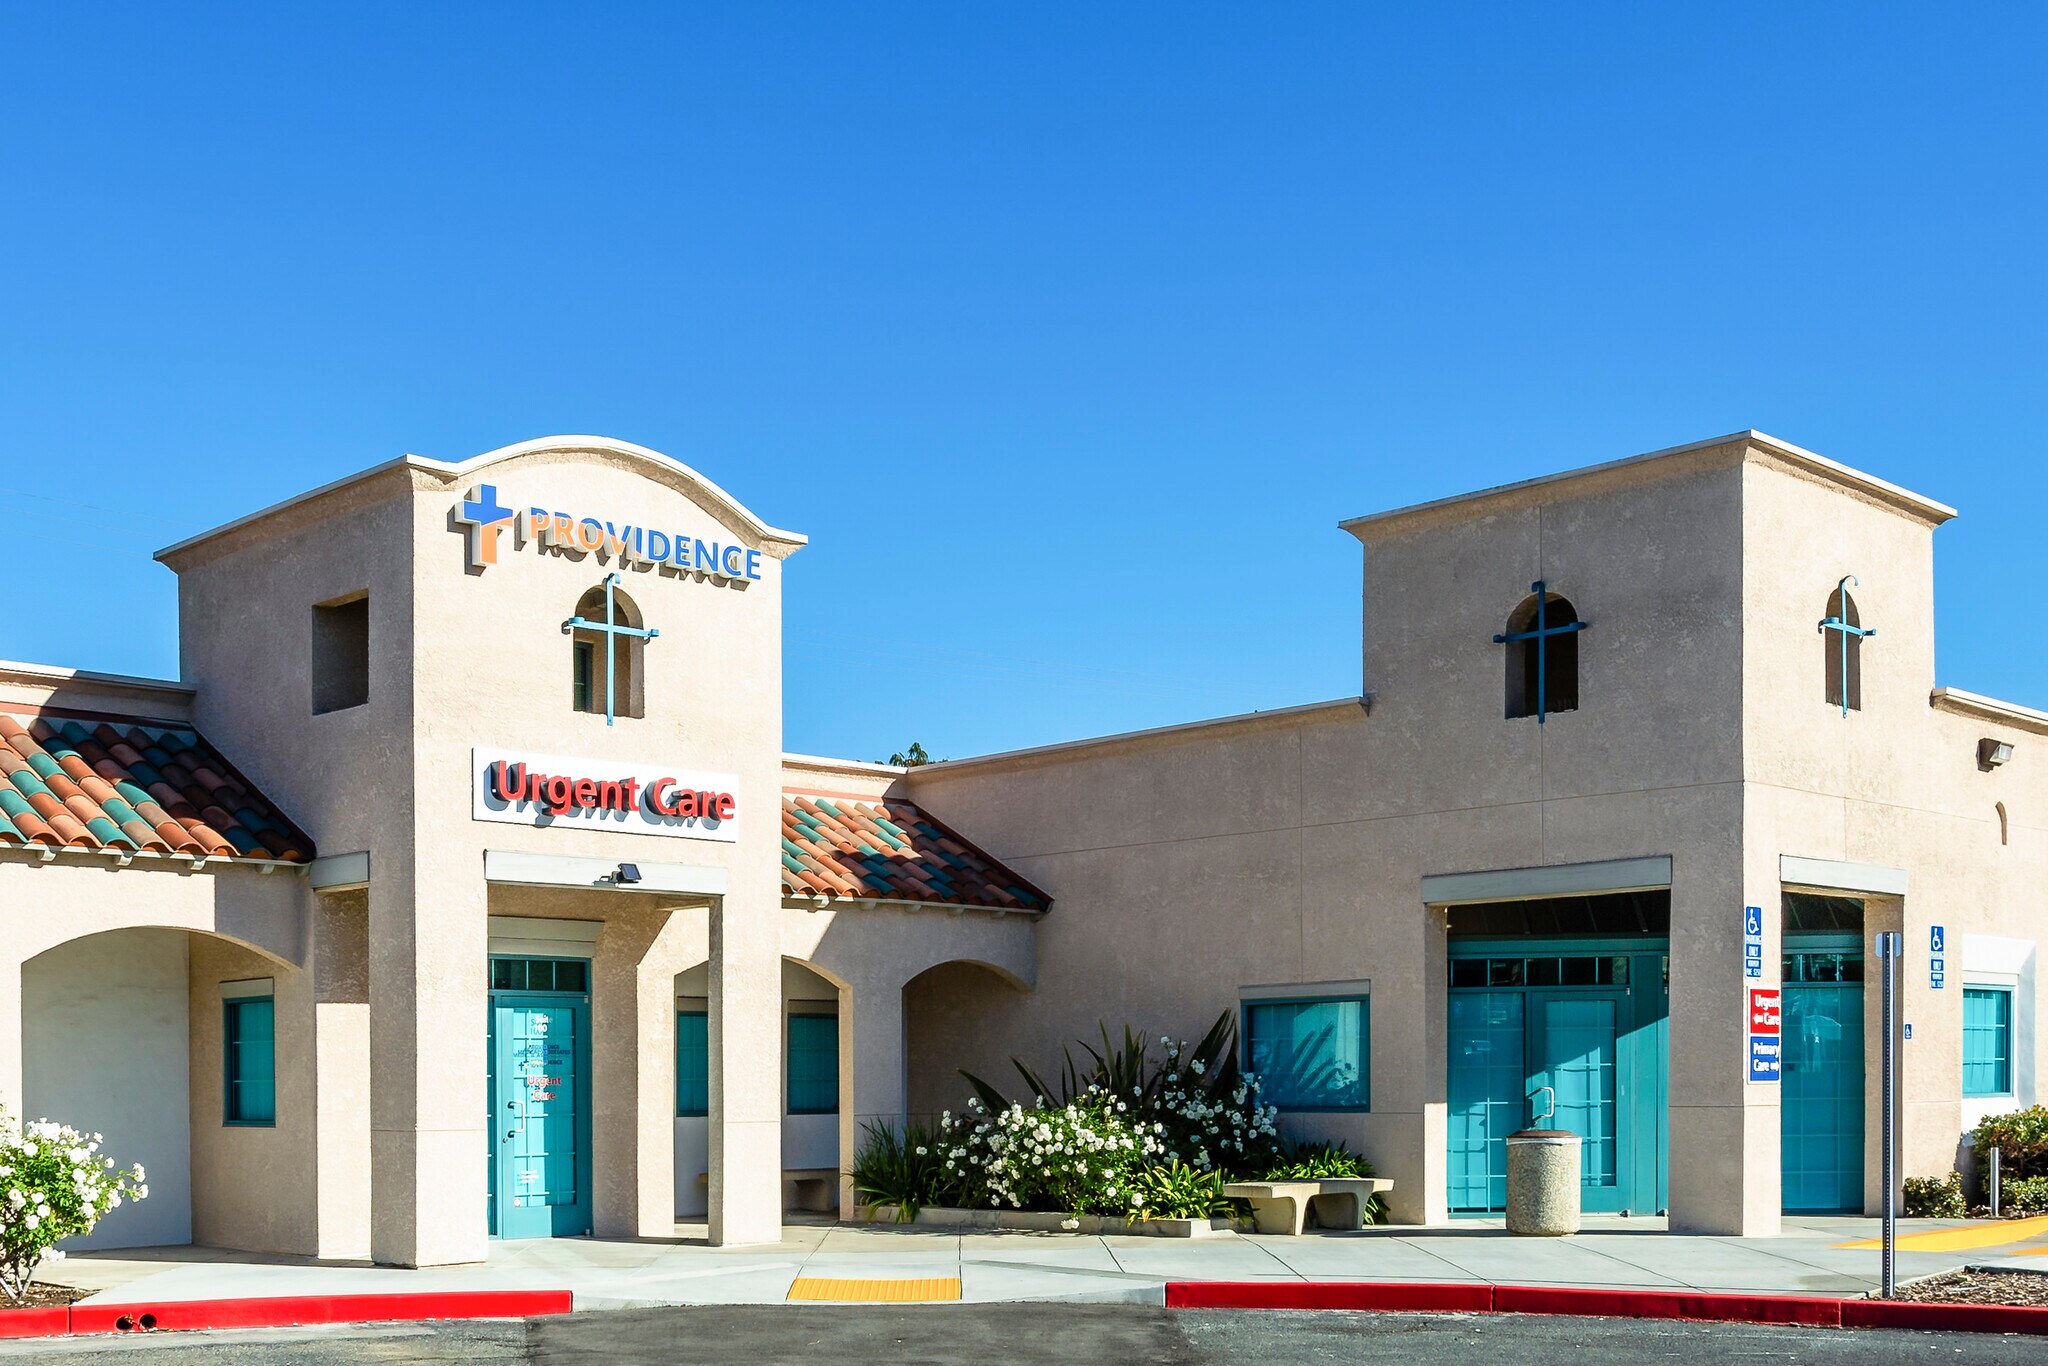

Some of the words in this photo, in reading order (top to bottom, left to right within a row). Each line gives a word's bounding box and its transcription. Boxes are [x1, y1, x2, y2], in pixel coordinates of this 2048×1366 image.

[529, 506, 762, 580] PROVIDENCE
[498, 760, 640, 815] Urgent
[653, 777, 735, 820] Care
[1755, 994, 1780, 1011] Urgent
[1764, 1012, 1780, 1026] Care
[1753, 1042, 1780, 1059] Primary
[1753, 1059, 1770, 1072] Care
[527, 1075, 562, 1089] Urgent
[533, 1090, 556, 1100] Care
